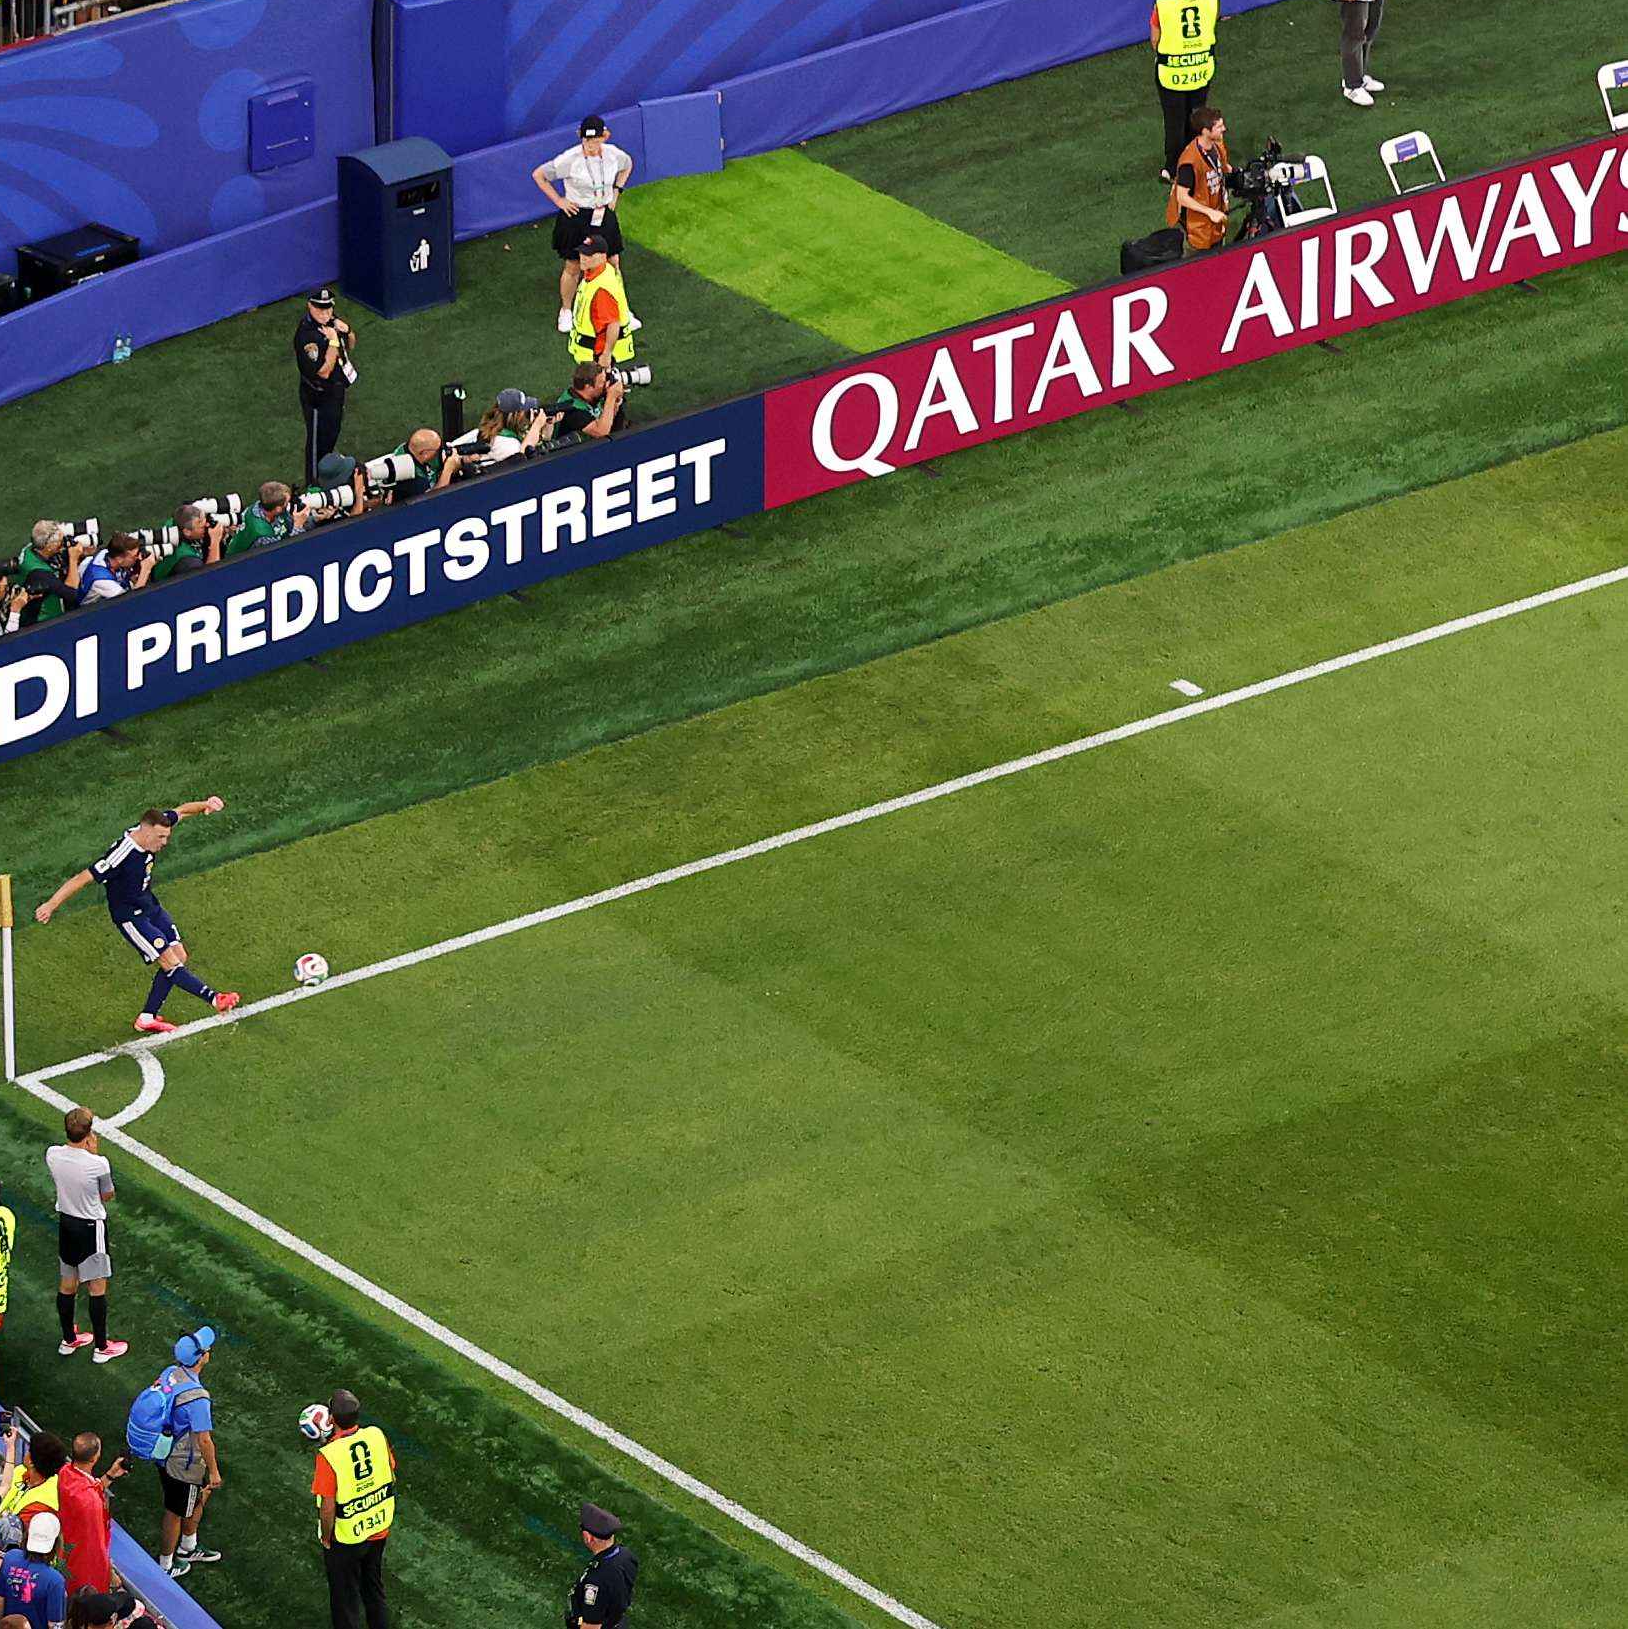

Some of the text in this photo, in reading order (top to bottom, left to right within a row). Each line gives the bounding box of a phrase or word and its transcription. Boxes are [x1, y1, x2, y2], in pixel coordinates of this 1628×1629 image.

[812, 144, 1628, 478] QATAR AIRWAY
[127, 438, 726, 690] PREDICTSTREET
[342, 1486, 389, 1518] SECURITY
